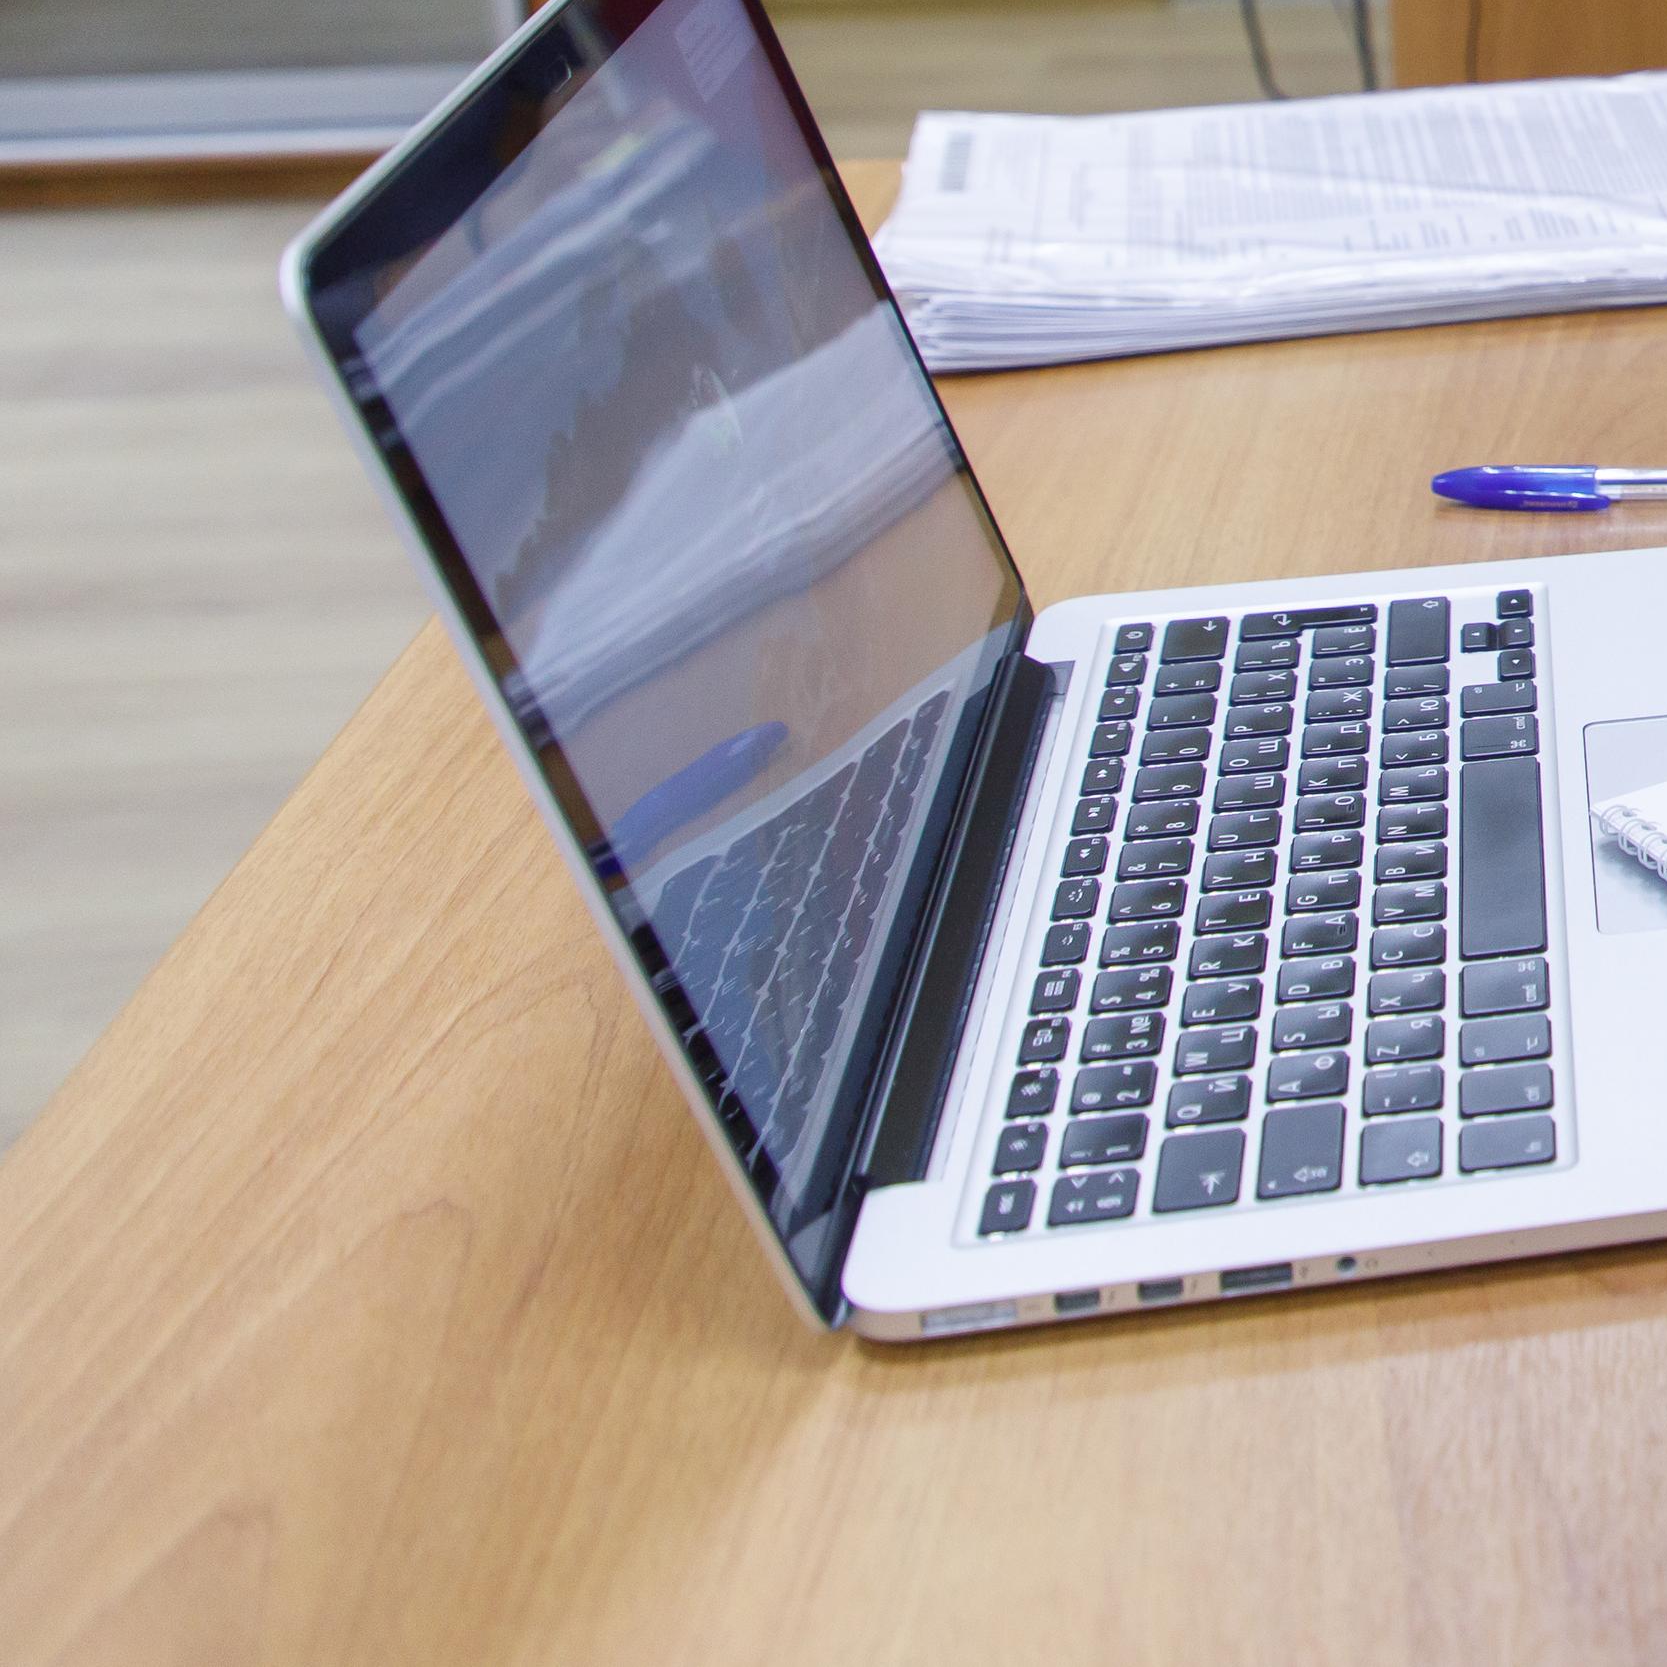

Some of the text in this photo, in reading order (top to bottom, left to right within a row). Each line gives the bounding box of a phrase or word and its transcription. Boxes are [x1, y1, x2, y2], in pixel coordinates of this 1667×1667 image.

[1234, 726, 1252, 734] P
[1390, 786, 1408, 795] M
[1167, 822, 1187, 831] 8
[1388, 826, 1406, 837] N
[1218, 835, 1238, 846] U
[1301, 855, 1321, 866] H
[1385, 867, 1405, 877] B
[1297, 896, 1317, 905] G
[1384, 909, 1403, 919] V
[1205, 919, 1227, 928] T
[1143, 946, 1163, 954] 5
[1382, 951, 1403, 960] C
[1199, 961, 1220, 970] R
[1288, 985, 1309, 994] D
[1136, 991, 1156, 999] 4
[1380, 996, 1400, 1007] X
[1192, 1009, 1215, 1017] E
[1131, 1016, 1150, 1033] №
[1283, 1033, 1305, 1042] S
[1126, 1040, 1148, 1049] 3
[1377, 1046, 1399, 1056] Z
[1278, 1081, 1300, 1092] A
[1117, 1090, 1140, 1101] 2
[1177, 1105, 1201, 1119] Q
